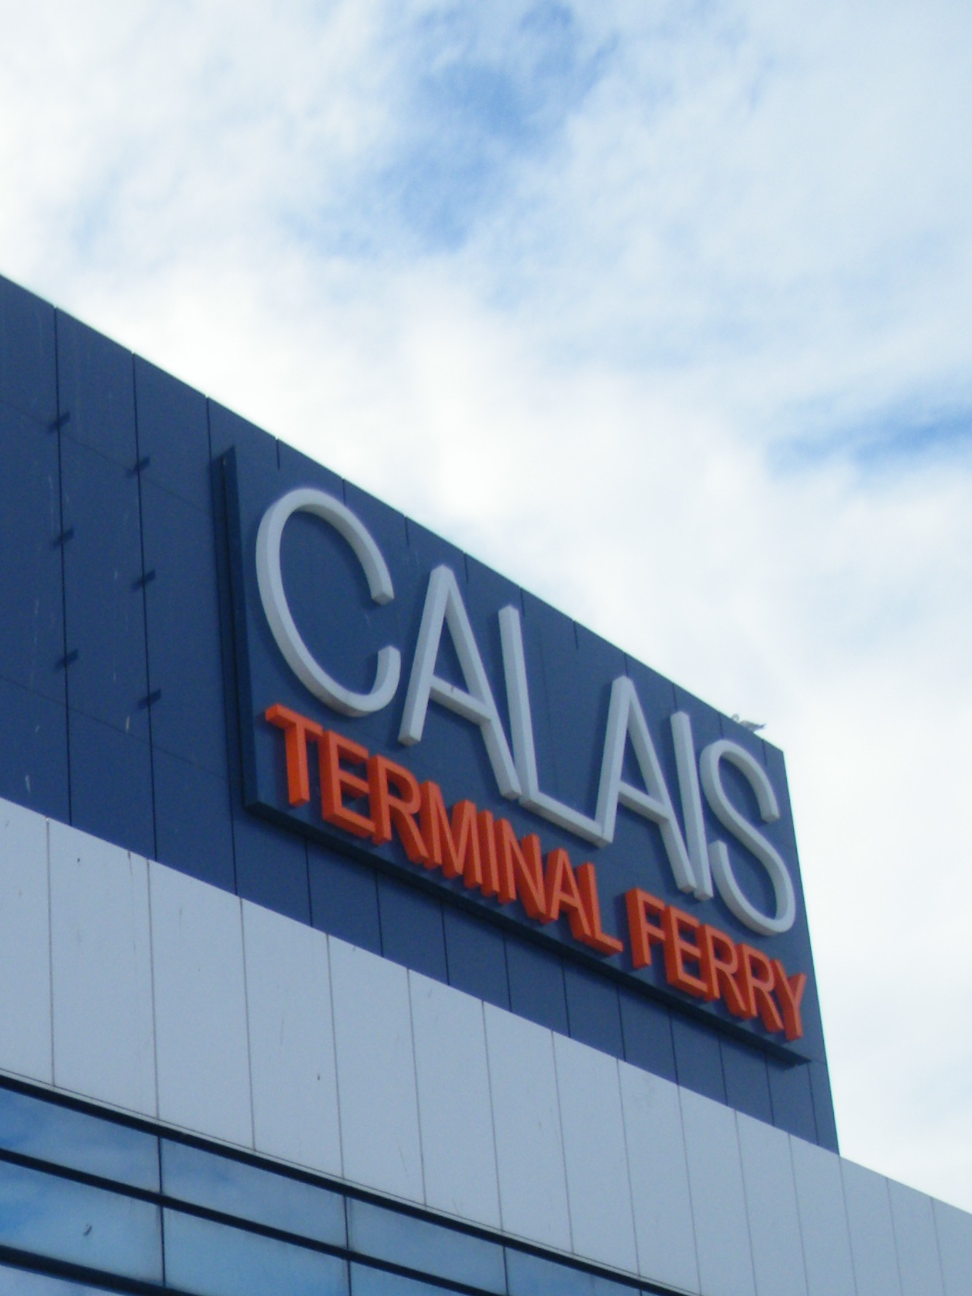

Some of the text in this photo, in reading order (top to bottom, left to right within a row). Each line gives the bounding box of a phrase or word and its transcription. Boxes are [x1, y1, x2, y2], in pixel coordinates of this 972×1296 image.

[255, 487, 797, 937] CALAIS
[264, 703, 808, 1042] TERMINAL FERRY
